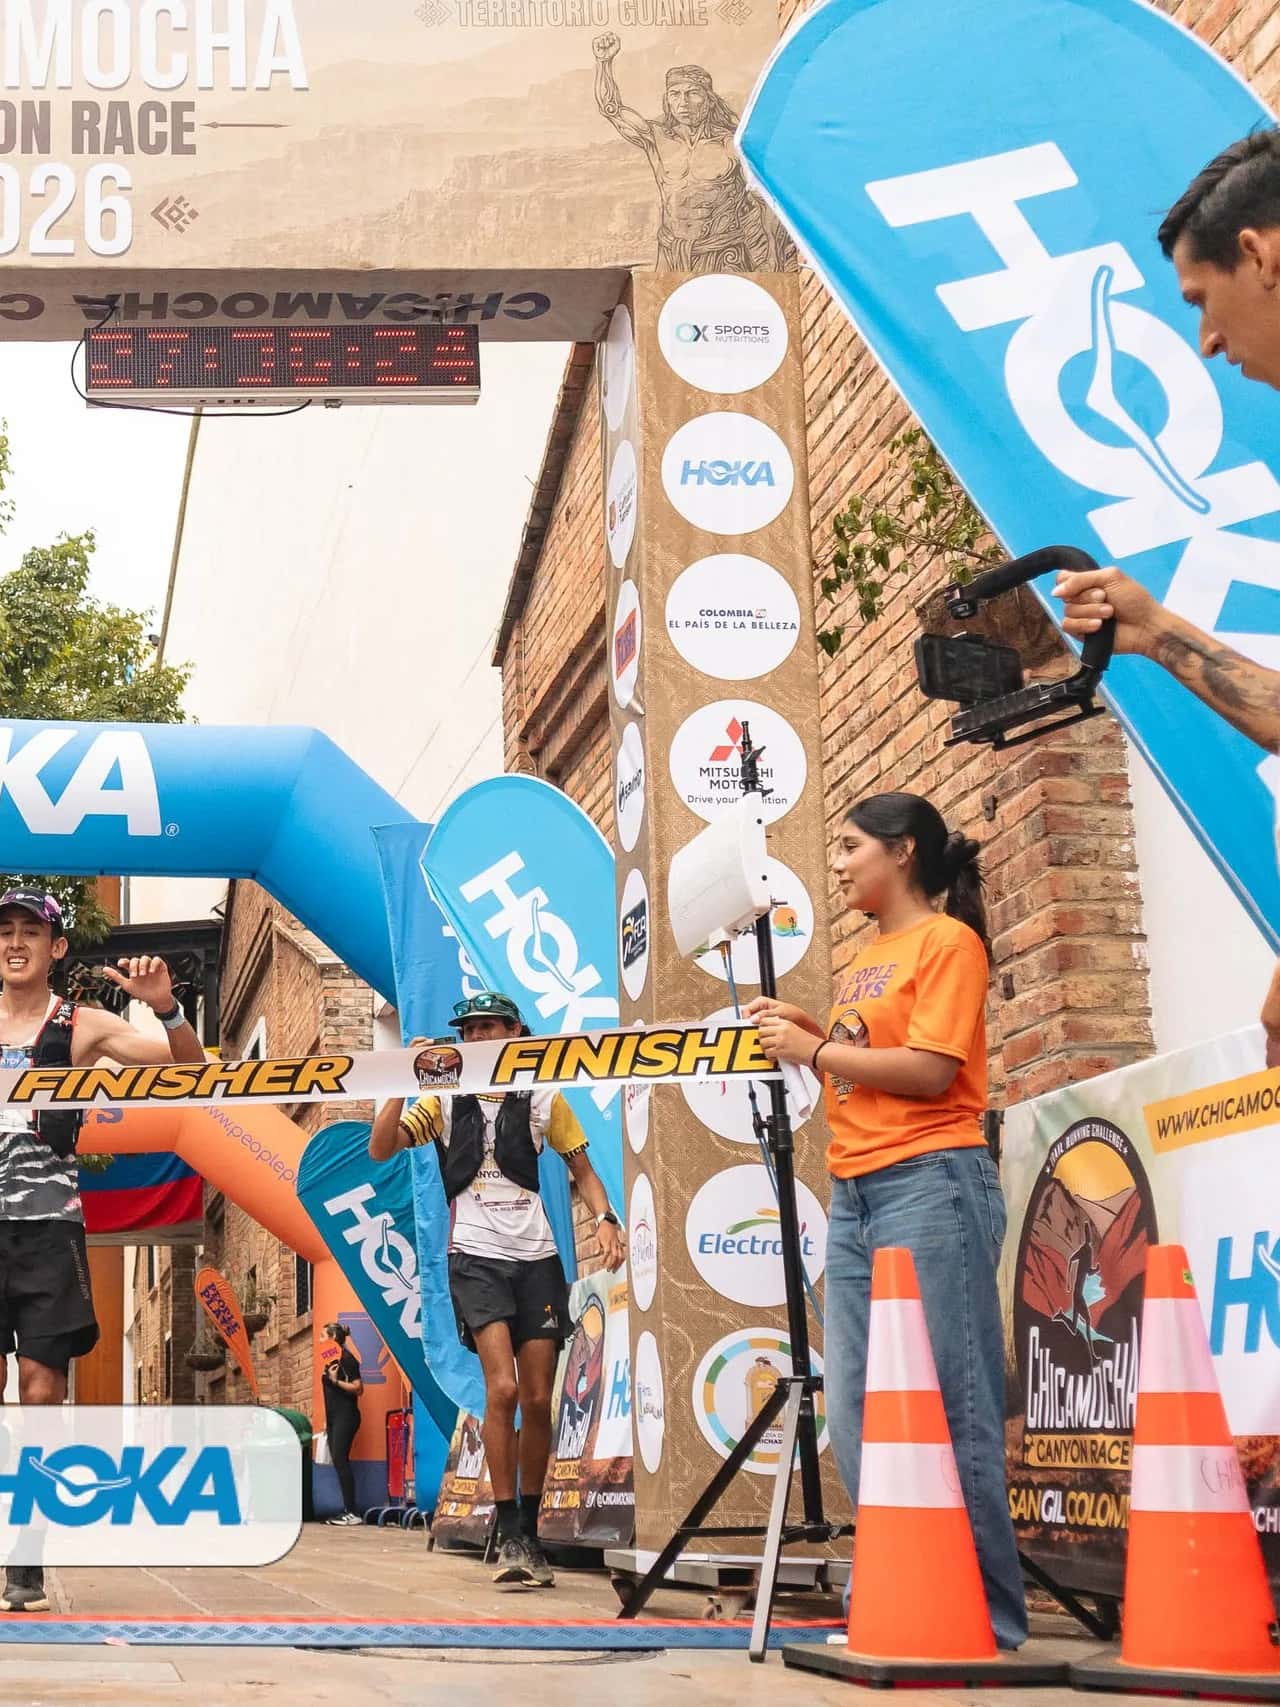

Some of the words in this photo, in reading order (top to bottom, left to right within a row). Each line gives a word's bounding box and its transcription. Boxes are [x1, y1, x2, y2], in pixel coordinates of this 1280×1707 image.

[456, 0, 614, 27] TERRITORIO
[618, 0, 709, 27] GUANE
[71, 100, 197, 155] RACE
[72, 290, 551, 322] CHICAMOCHA
[714, 325, 770, 336] SPORTS
[680, 459, 776, 487] HOKA
[669, 620, 680, 628] EL
[715, 621, 728, 629] DE
[733, 621, 746, 629] LA
[751, 622, 797, 630] BELLEZA
[699, 608, 754, 617] COLOMBIA
[687, 795, 713, 804] Drive
[490, 1024, 779, 1087] FINISHE
[6, 1055, 353, 1103] FINISHER
[1027, 1316, 1140, 1429] CHICAMOCHA
[1036, 1438, 1089, 1465] CANYON
[1089, 1439, 1129, 1466] RACE
[1008, 1488, 1043, 1521] SAN
[1041, 1489, 1067, 1525] GIL
[1066, 1491, 1129, 1529] COLOM
